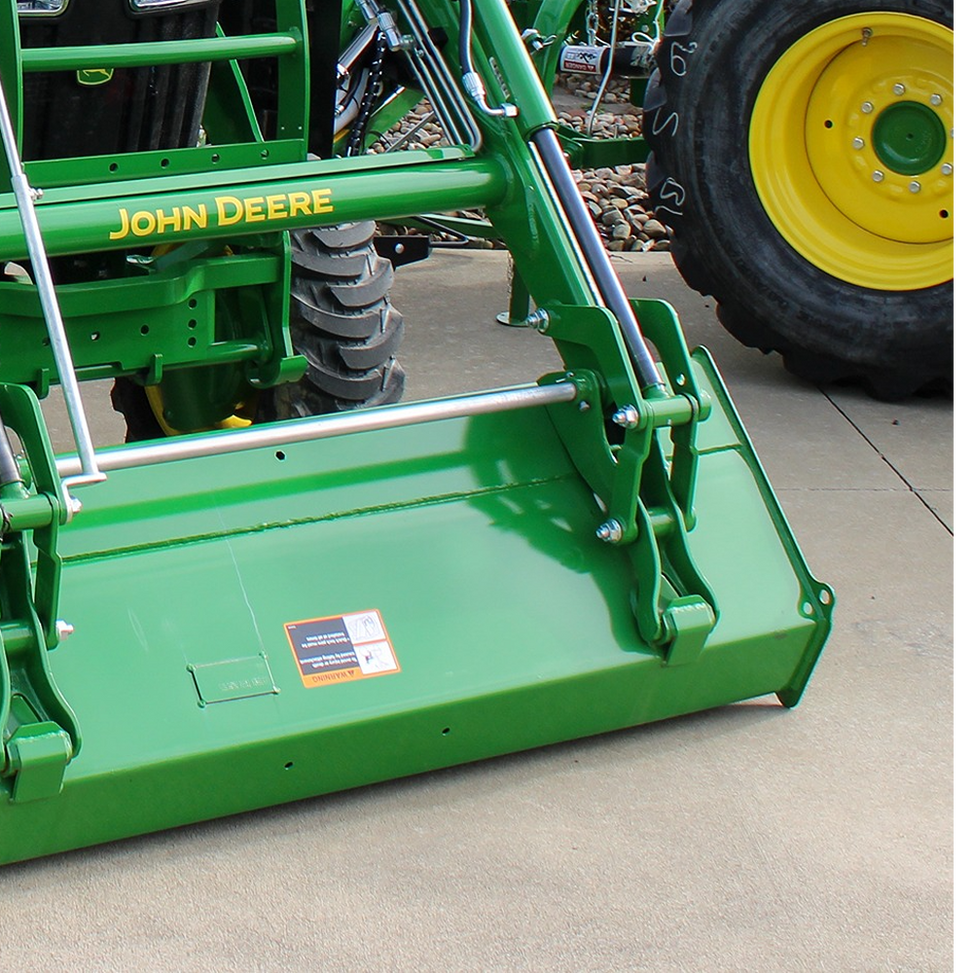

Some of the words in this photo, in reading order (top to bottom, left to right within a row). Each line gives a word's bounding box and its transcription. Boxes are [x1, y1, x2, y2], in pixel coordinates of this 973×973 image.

[109, 203, 207, 240] JOHN
[214, 188, 334, 226] DEERE
[312, 671, 347, 683] WARNING
